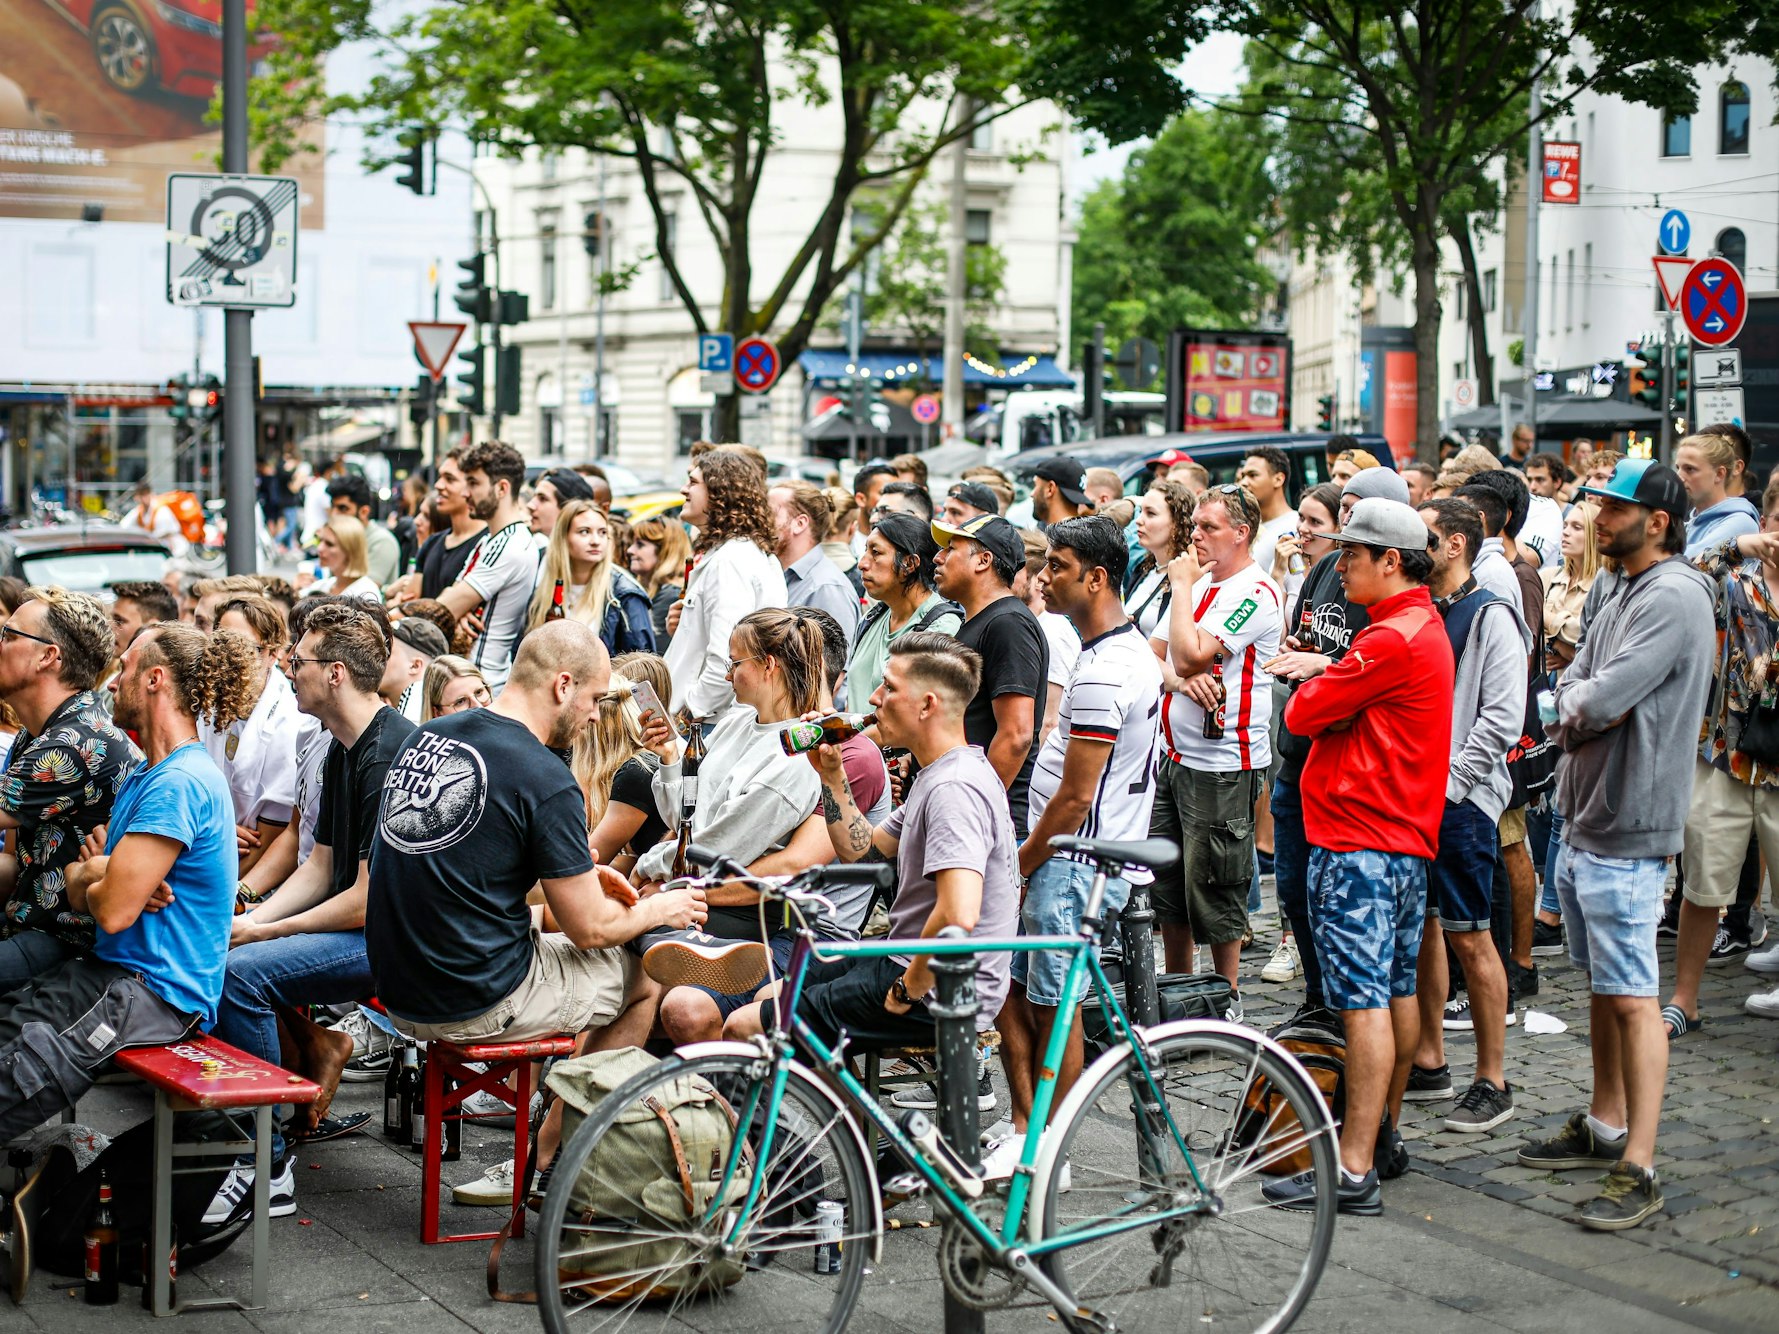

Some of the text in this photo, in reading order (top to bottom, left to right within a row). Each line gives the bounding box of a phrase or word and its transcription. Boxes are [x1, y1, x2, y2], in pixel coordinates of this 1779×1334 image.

[1545, 144, 1579, 159] REWE
[702, 339, 722, 368] P
[1227, 603, 1255, 630] DEVK
[1312, 618, 1352, 647] ALDING
[416, 731, 460, 757] THE
[398, 748, 447, 774] IRON
[383, 769, 434, 795] DEATH
